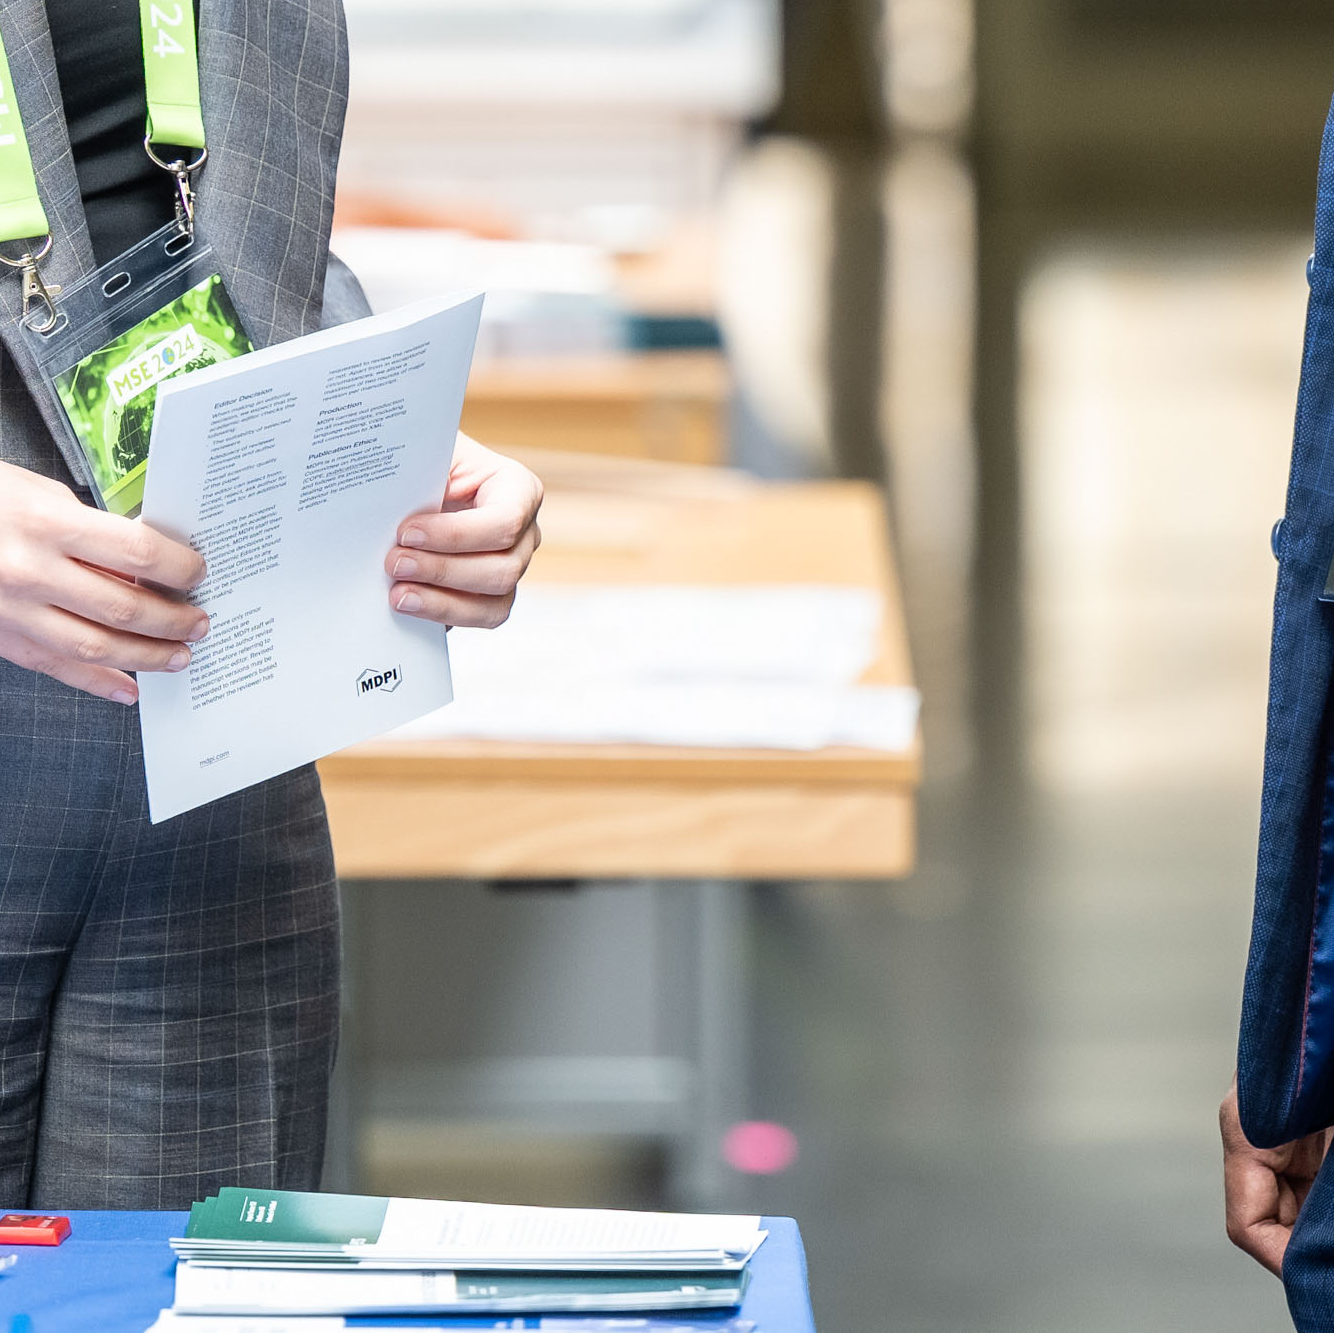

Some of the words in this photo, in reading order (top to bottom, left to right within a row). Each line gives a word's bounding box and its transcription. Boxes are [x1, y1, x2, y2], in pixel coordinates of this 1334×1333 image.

[113, 361, 153, 397] MSE
[214, 399, 237, 410] Editor
[238, 388, 273, 402] Decision
[319, 401, 363, 417] Production
[308, 445, 352, 461] Publication
[353, 438, 377, 448] Ethics
[251, 622, 264, 632] staff
[188, 652, 211, 667] request
[236, 636, 254, 647] author
[256, 628, 273, 639] revise
[200, 660, 217, 672] paper
[219, 652, 237, 663] before
[238, 641, 263, 655] referring
[201, 664, 229, 679] academic
[231, 657, 249, 667] editor.
[251, 645, 274, 659] Revised
[191, 674, 224, 692] manuscript
[225, 665, 250, 679] versions
[192, 684, 222, 701] forwarded
[230, 671, 258, 686] reviewers
[259, 662, 277, 674] based
[361, 668, 398, 693] MDPI
[202, 693, 225, 707] whether
[237, 679, 262, 692] reviewer
[199, 750, 229, 769] mdpi.com
